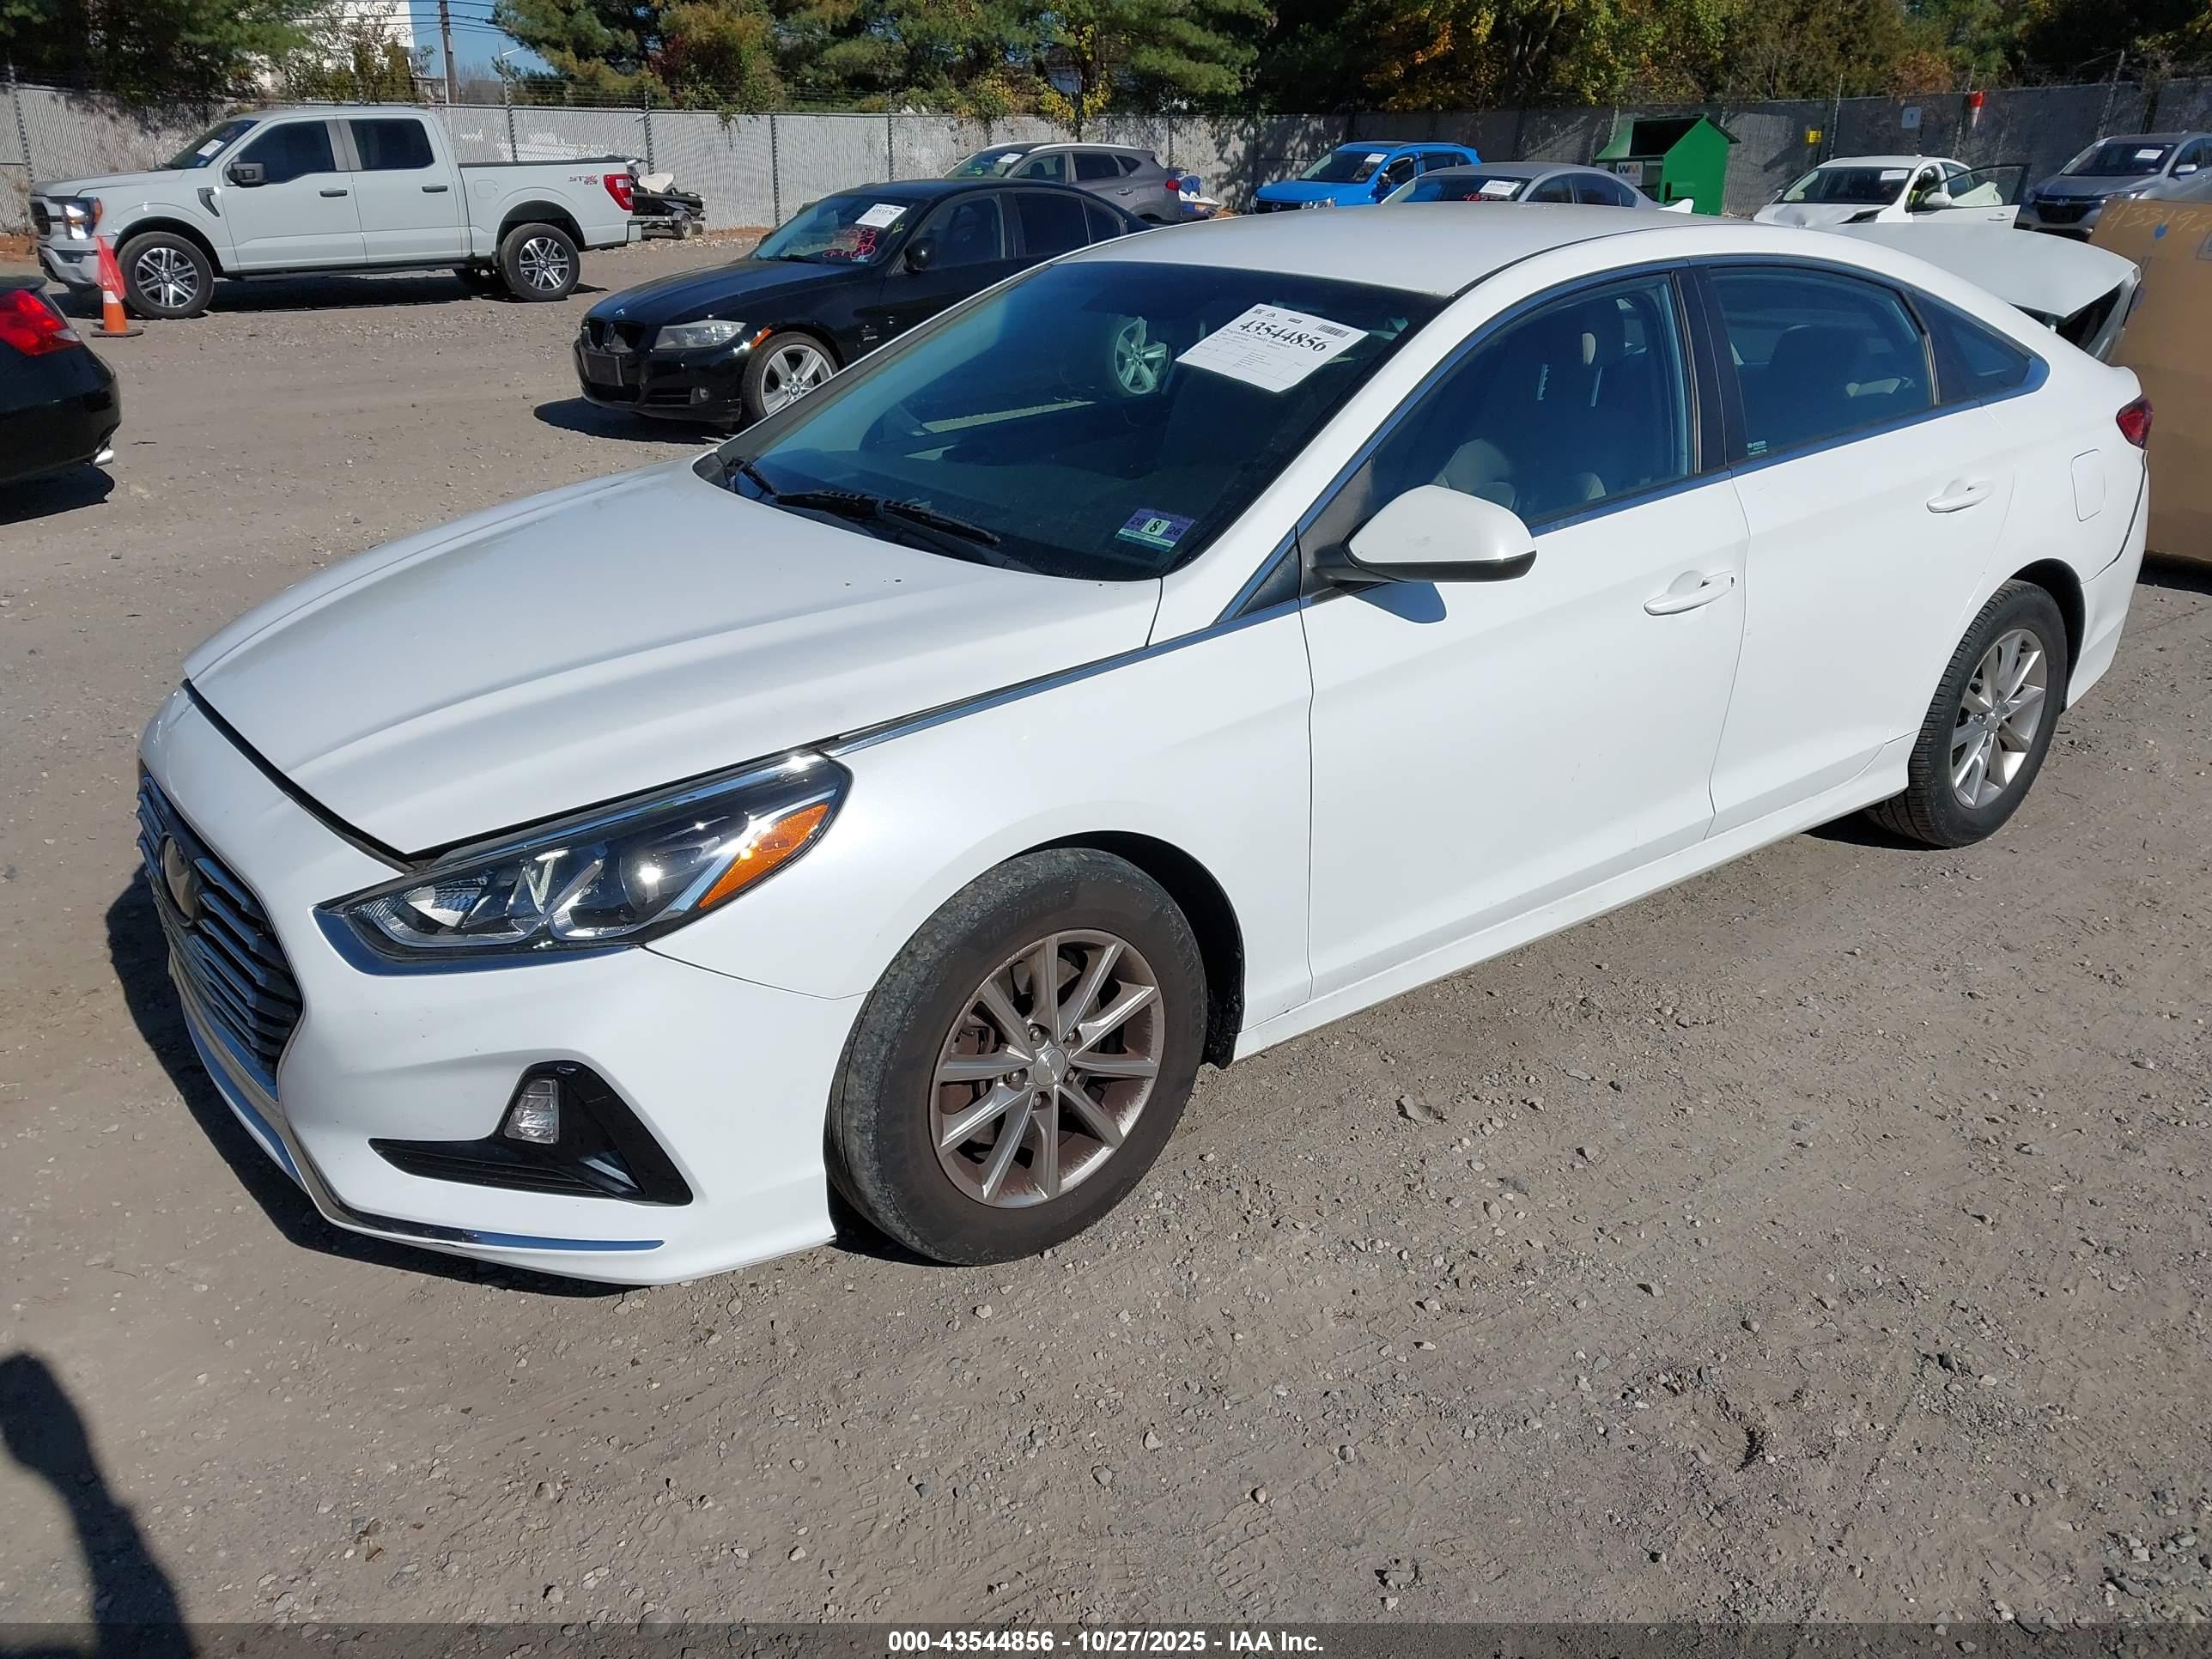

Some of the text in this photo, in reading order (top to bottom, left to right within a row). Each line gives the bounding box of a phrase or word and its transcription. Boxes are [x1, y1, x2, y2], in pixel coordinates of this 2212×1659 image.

[1618, 164, 1639, 173] WM
[1238, 319, 1333, 352] 43544856
[1148, 520, 1162, 533] 8
